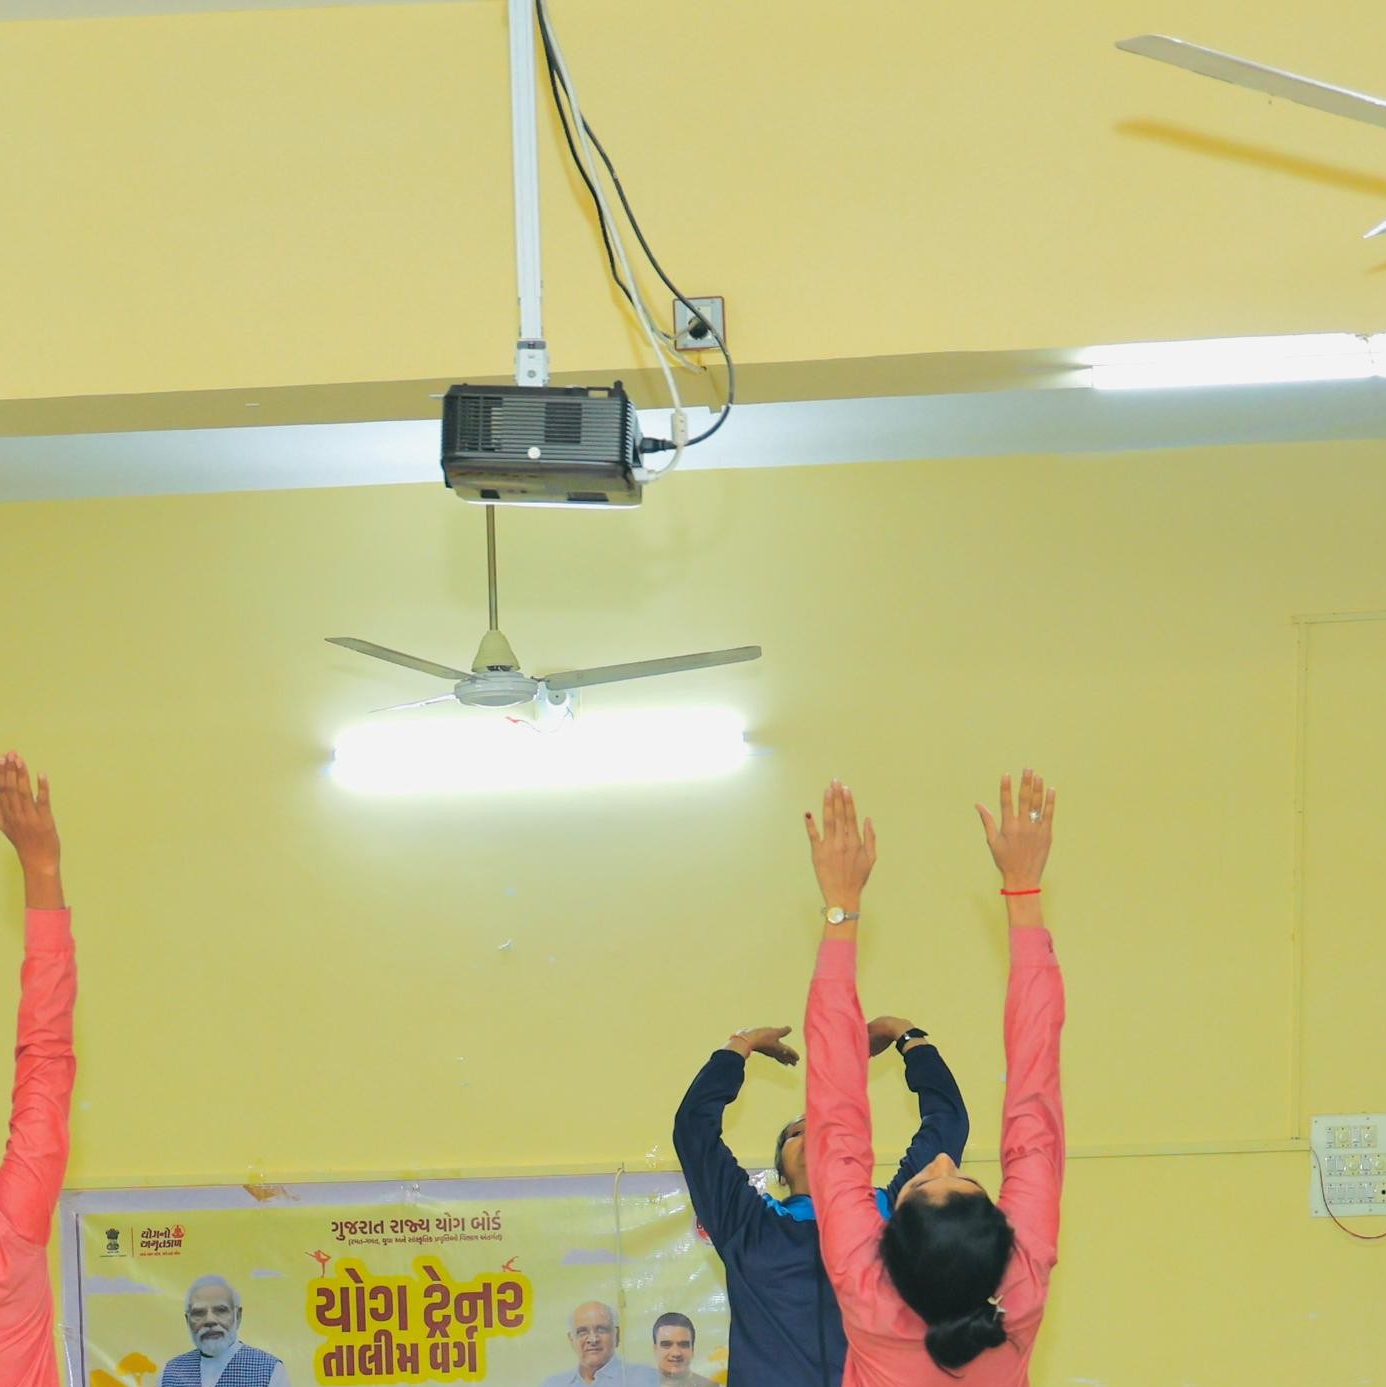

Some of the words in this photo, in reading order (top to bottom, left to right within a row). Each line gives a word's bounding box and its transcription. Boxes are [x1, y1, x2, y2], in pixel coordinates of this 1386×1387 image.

[331, 1220, 384, 1241] ગુજરાત
[390, 1218, 430, 1234] રાજ્ય
[436, 1213, 465, 1232] યોગ
[471, 1210, 501, 1231] બોર્ડ
[316, 1268, 407, 1332] યોગ
[423, 1265, 524, 1338] ટ્રેનર
[323, 1329, 419, 1377] તાલીમ
[429, 1326, 478, 1373] વર્ગ
